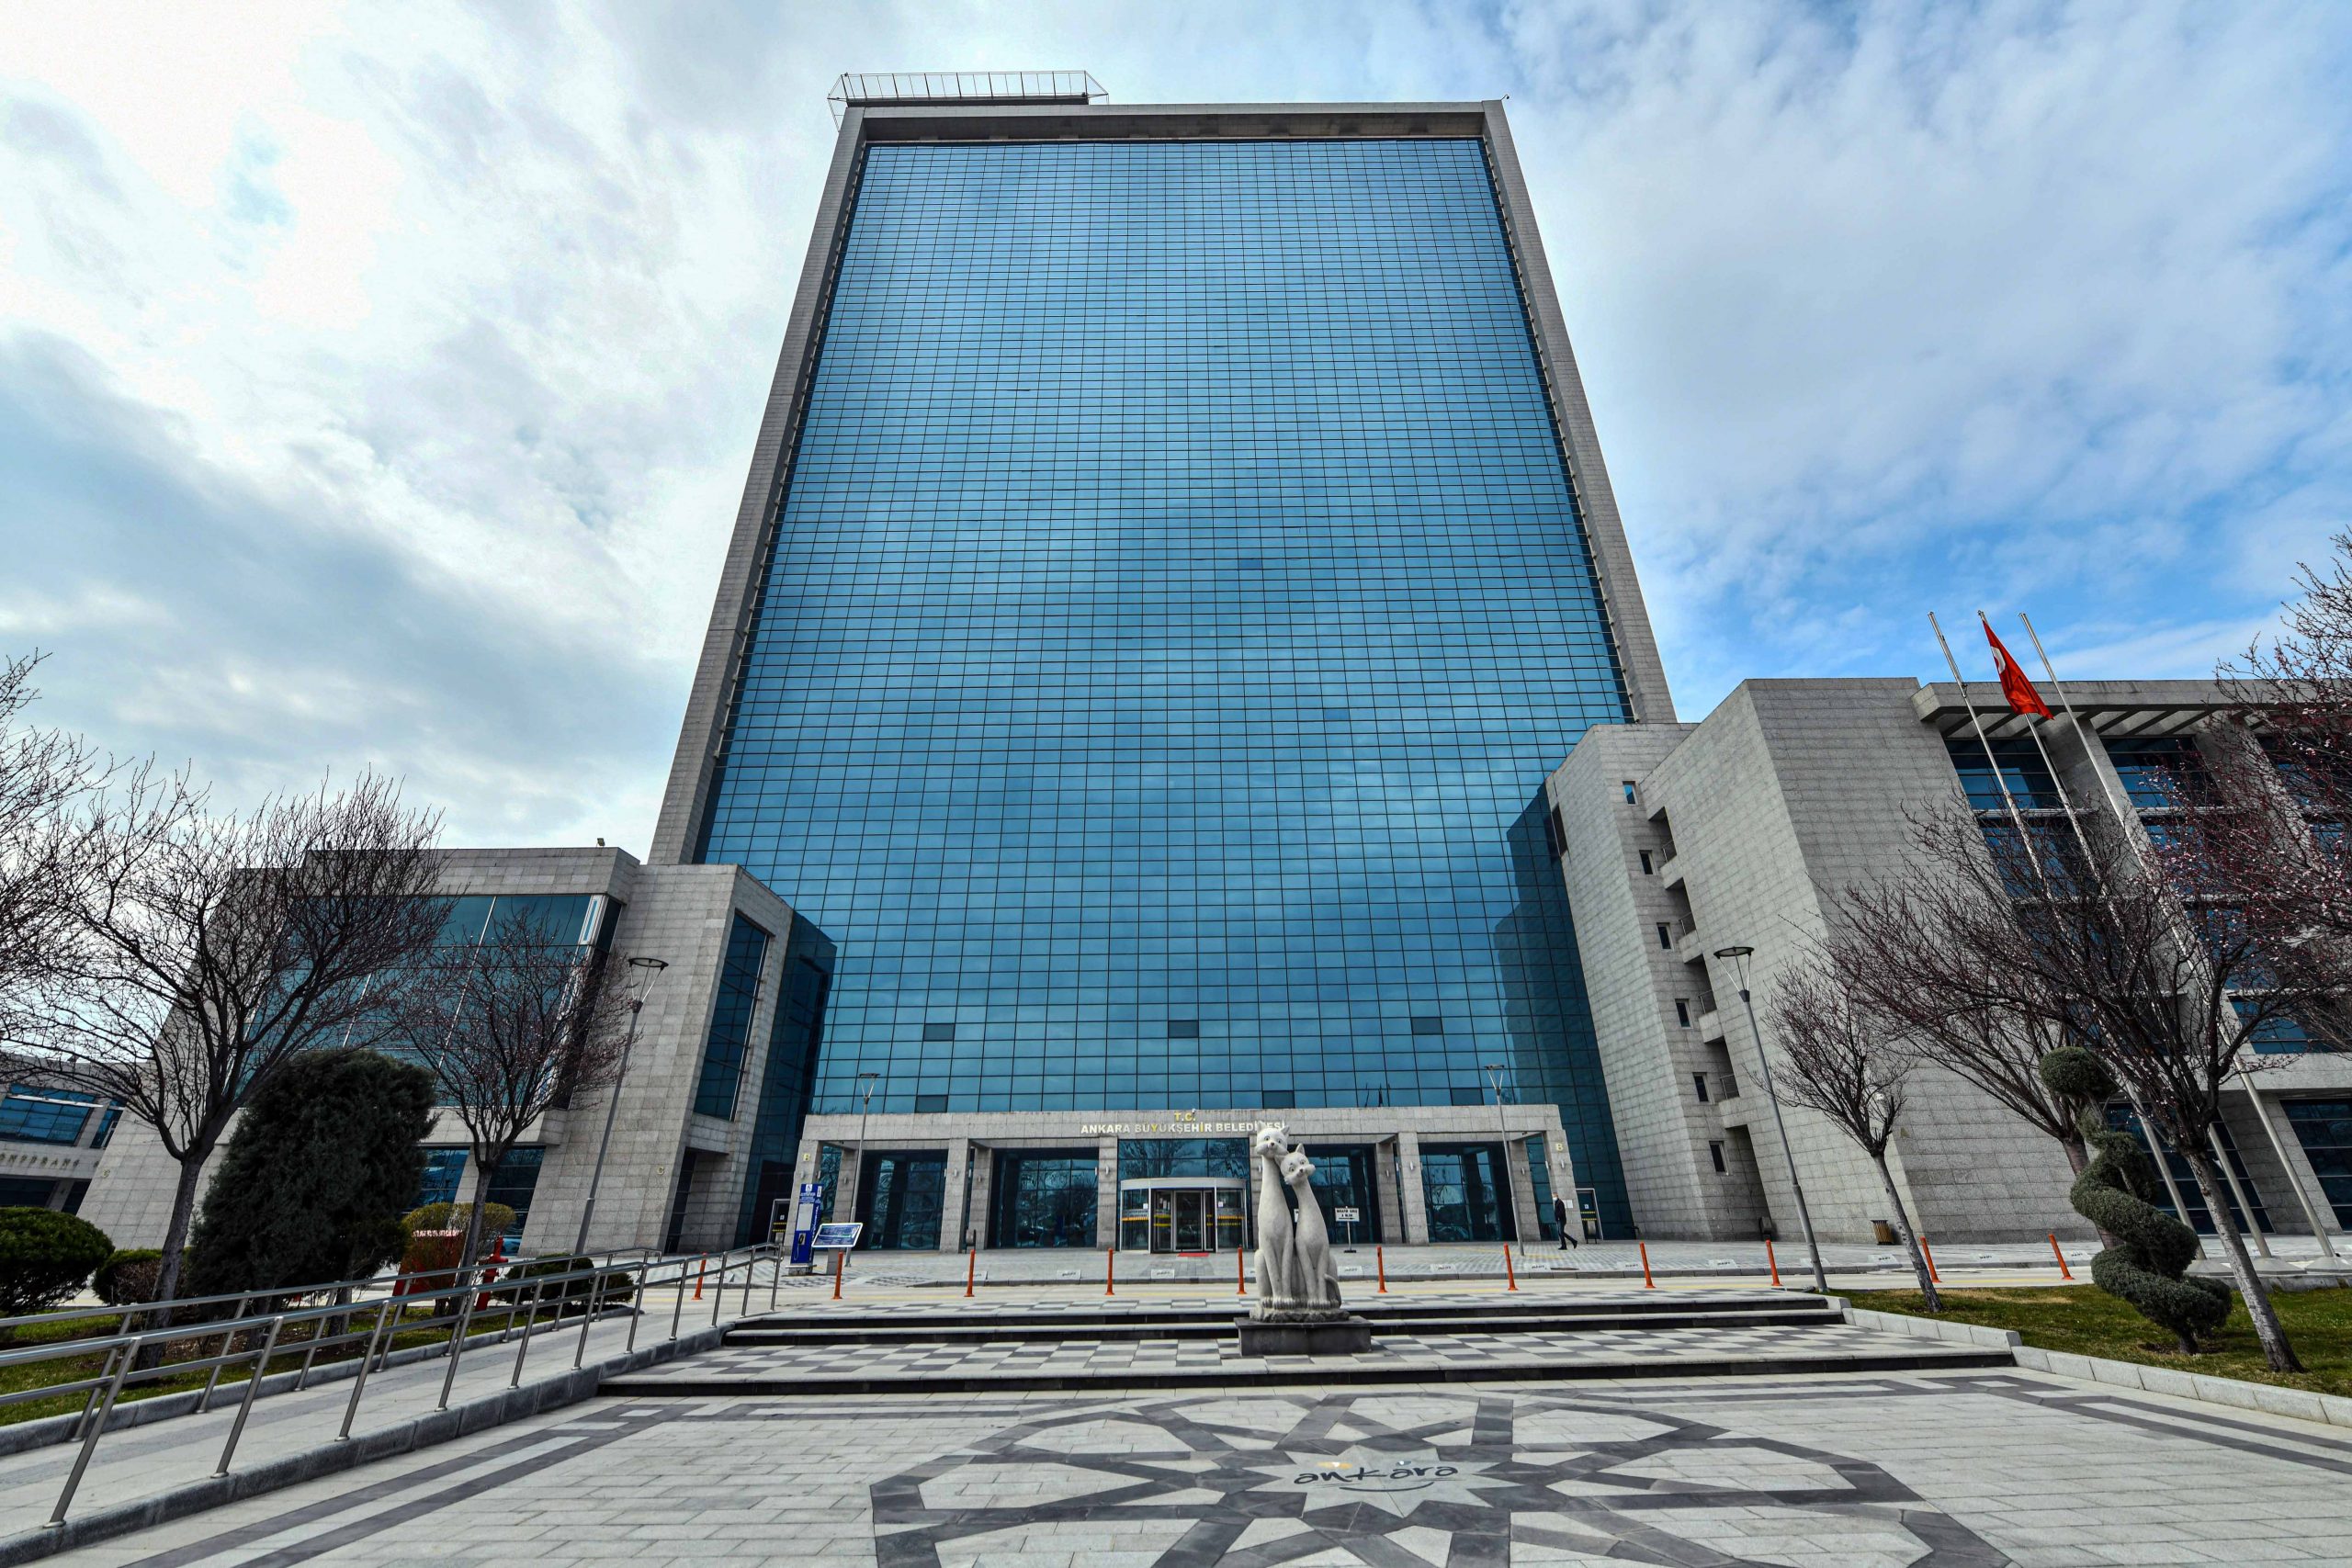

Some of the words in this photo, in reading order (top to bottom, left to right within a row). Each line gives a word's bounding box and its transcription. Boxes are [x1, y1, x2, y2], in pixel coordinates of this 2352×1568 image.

[1174, 1112, 1196, 1122] T.C.
[1080, 1123, 1131, 1134] ANKARA
[1134, 1121, 1213, 1134] BÜYÜKŞEHİR
[1555, 1143, 1564, 1152] B
[1294, 1467, 1459, 1484] ankara
